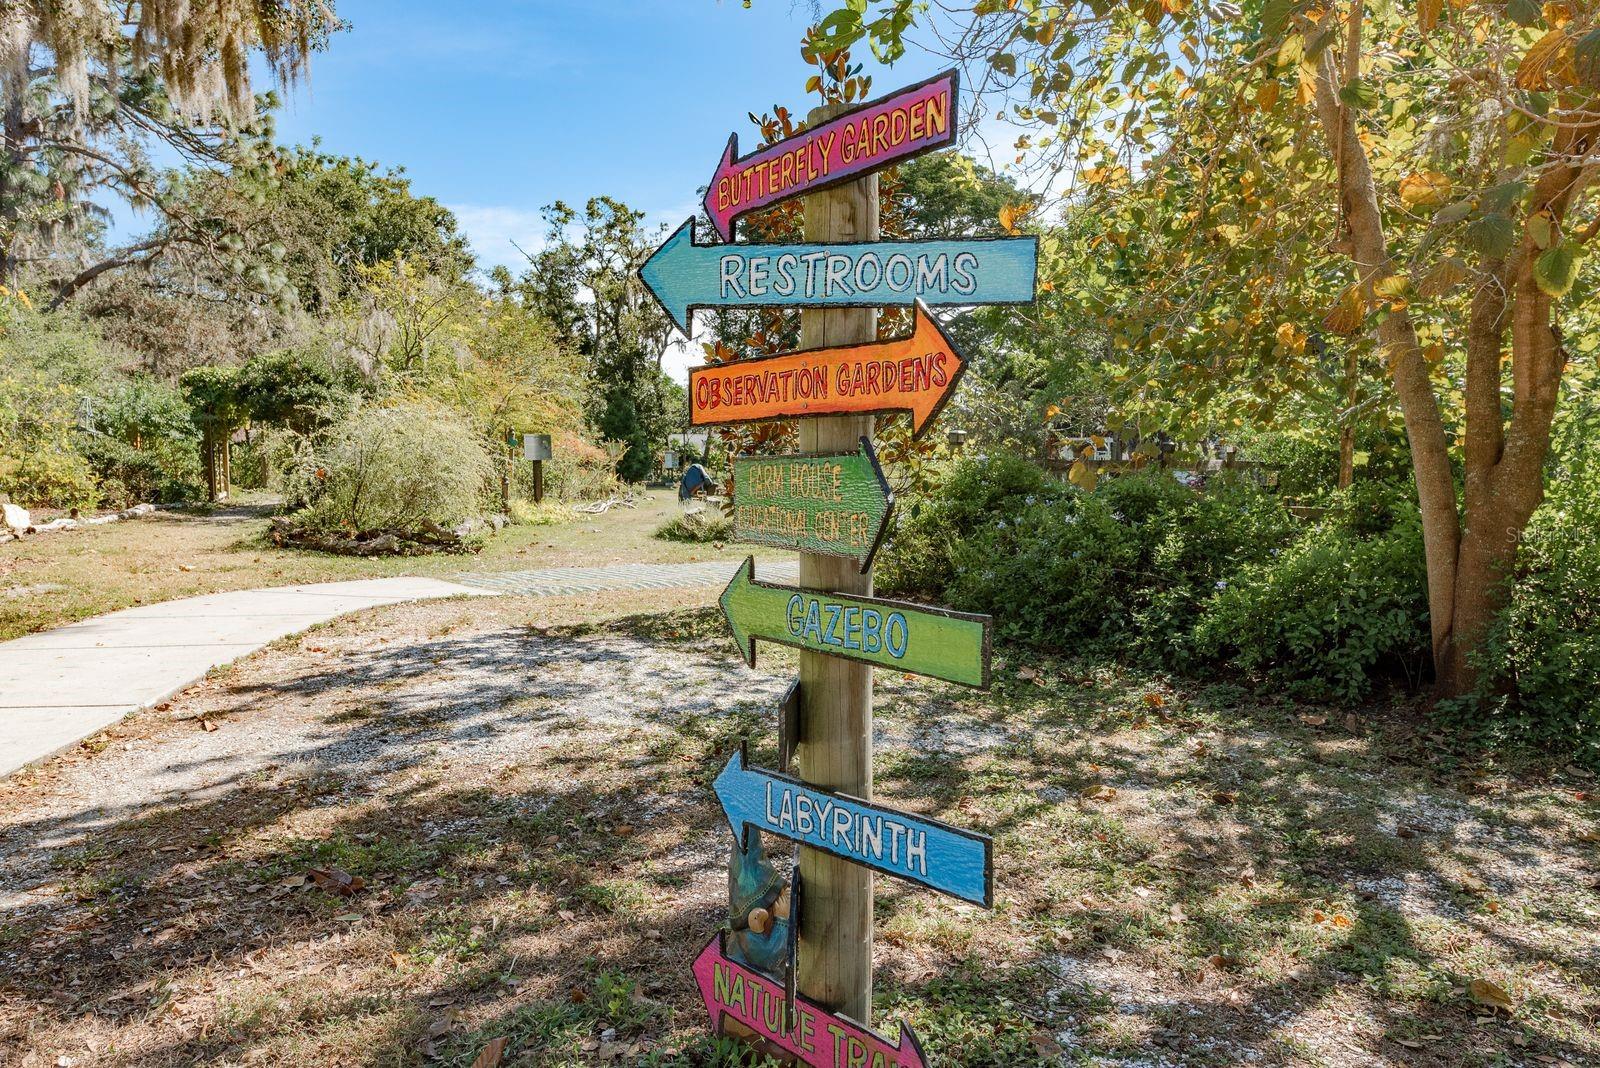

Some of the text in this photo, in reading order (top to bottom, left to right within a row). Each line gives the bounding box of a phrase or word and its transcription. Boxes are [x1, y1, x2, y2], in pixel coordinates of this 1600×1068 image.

[717, 91, 947, 213] BUTTERFLY GARDEN
[719, 252, 979, 299] RESTROOMS
[695, 352, 948, 410] OBSERVATION GARDENS
[749, 461, 842, 502] FARM HOUSE
[786, 593, 909, 660] GAZEBO
[765, 781, 929, 877] LABYRINTH
